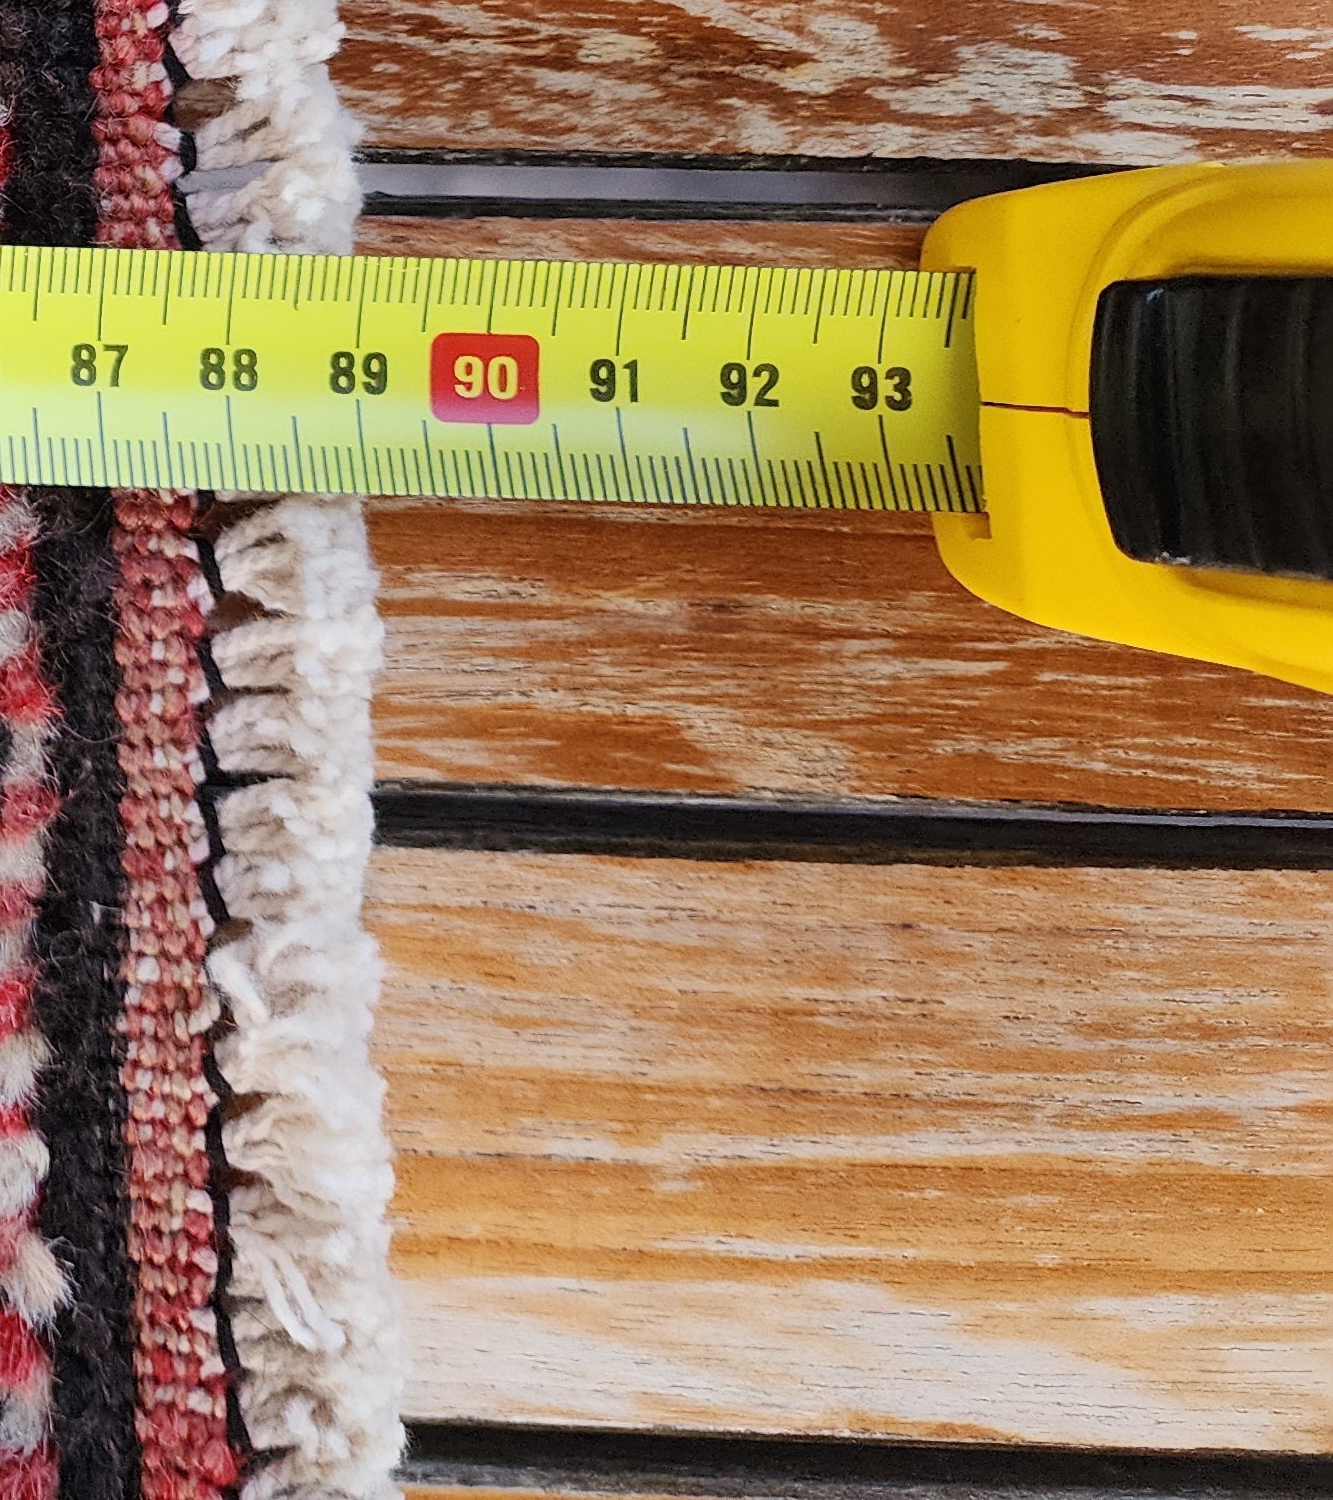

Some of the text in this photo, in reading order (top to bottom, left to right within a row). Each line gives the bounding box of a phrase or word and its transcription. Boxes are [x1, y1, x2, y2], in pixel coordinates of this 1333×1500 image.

[70, 344, 129, 388] 87
[199, 348, 259, 392] 88
[329, 352, 389, 396] 89
[453, 356, 519, 400] 90
[589, 359, 641, 403] 91
[719, 362, 780, 408] 92
[850, 366, 913, 411] 93
